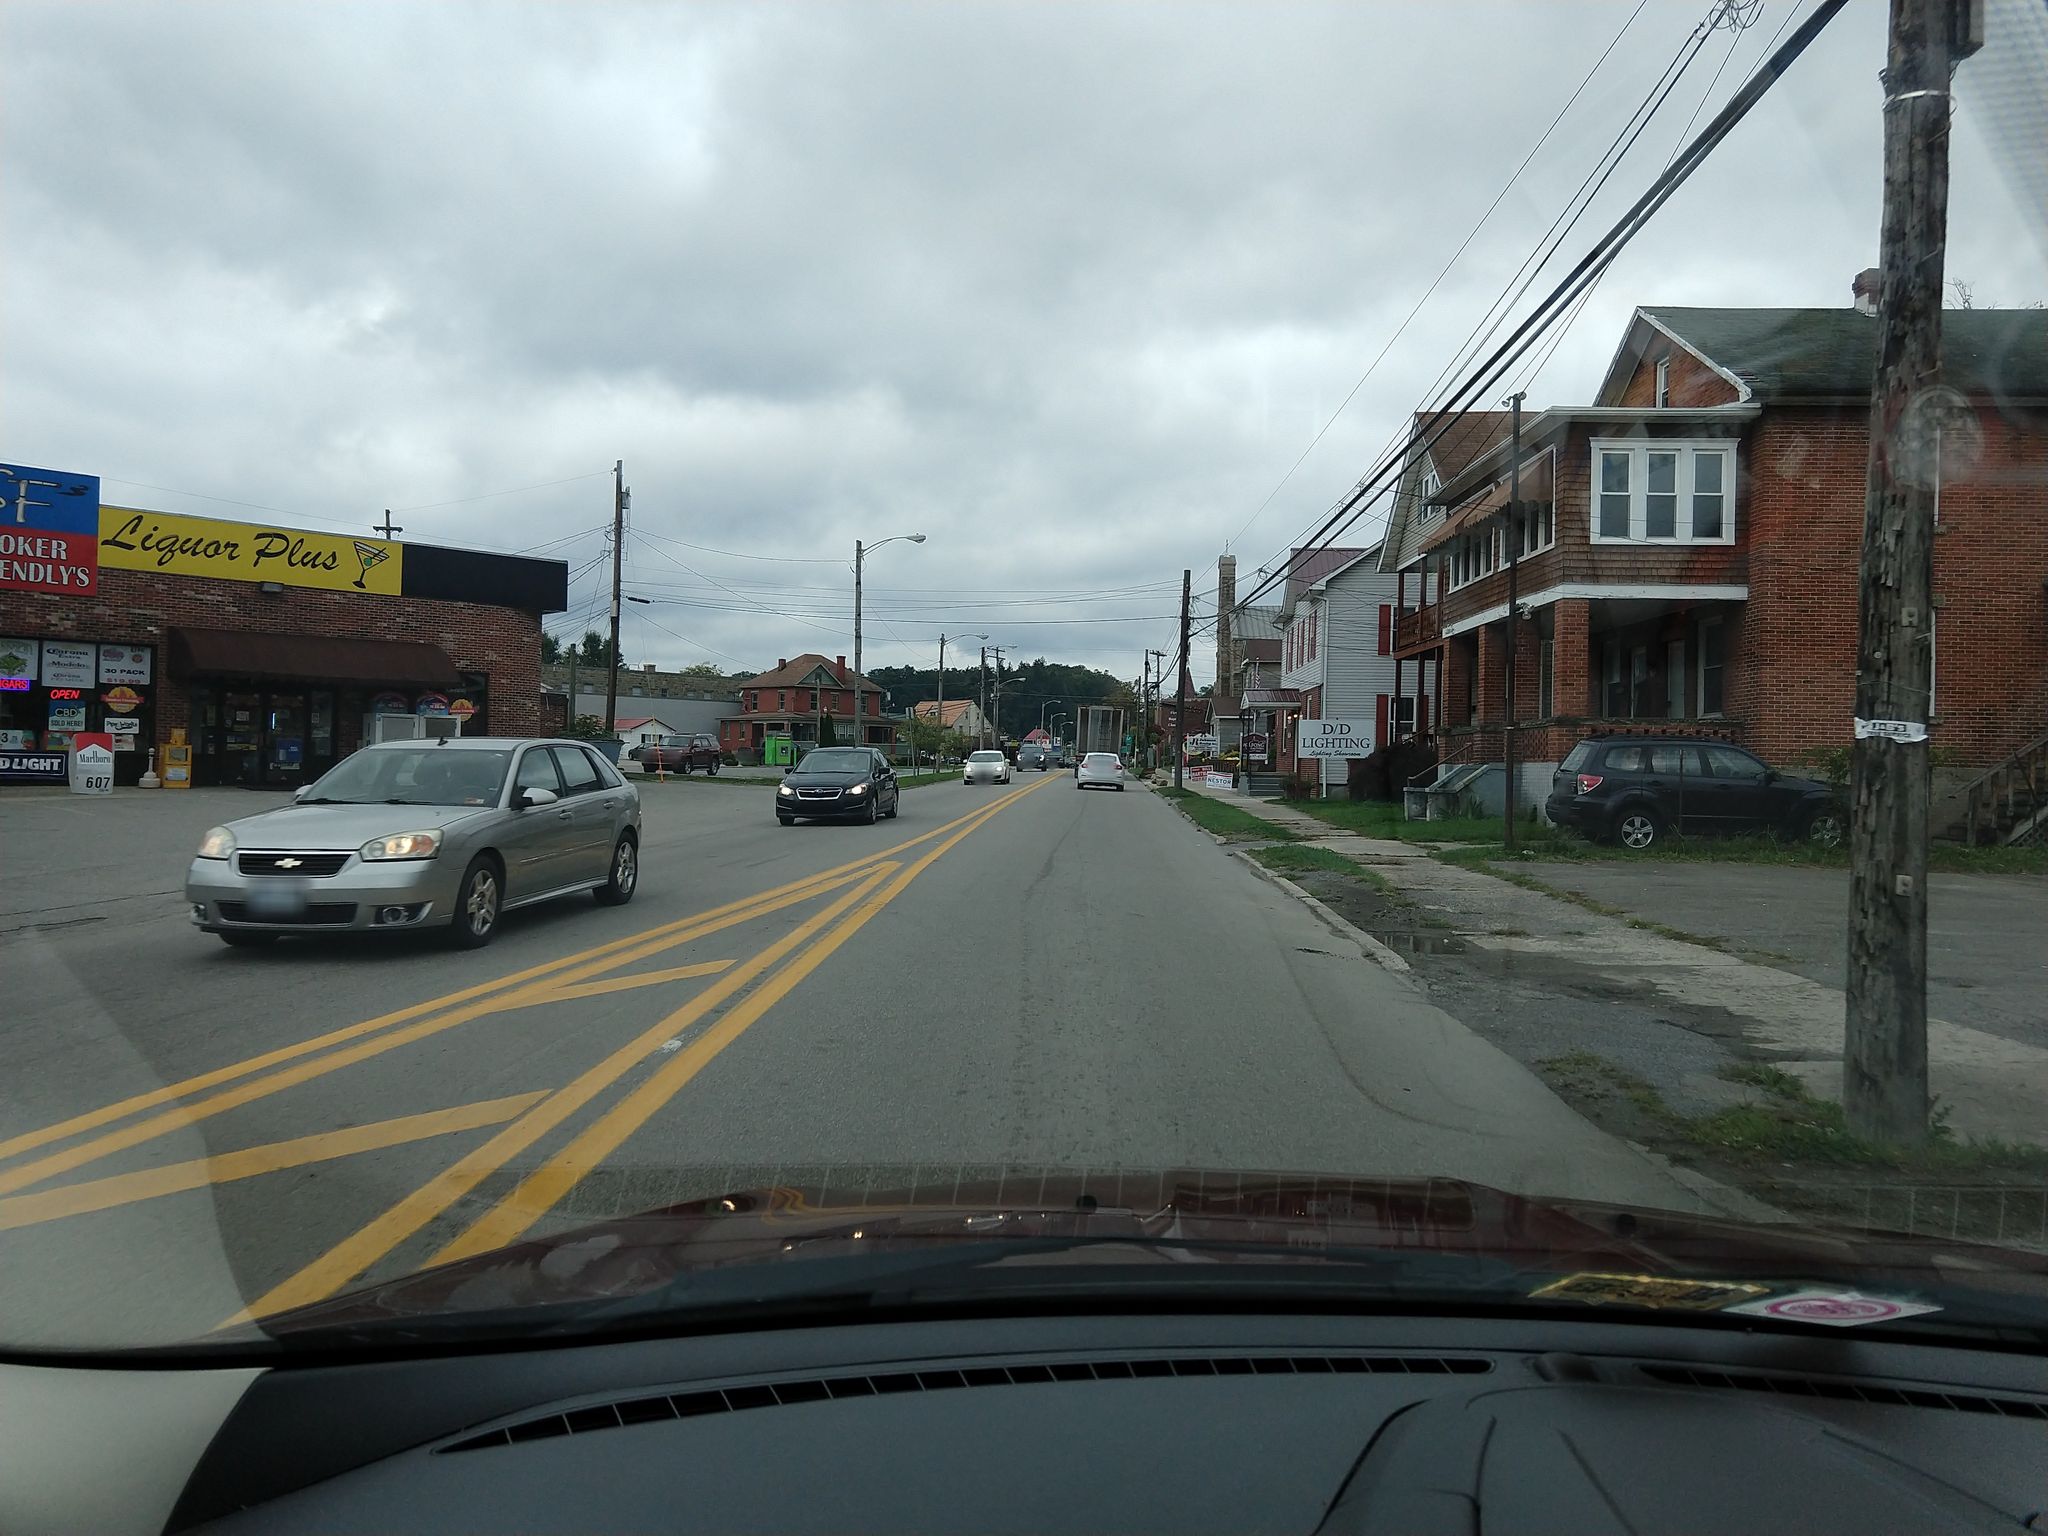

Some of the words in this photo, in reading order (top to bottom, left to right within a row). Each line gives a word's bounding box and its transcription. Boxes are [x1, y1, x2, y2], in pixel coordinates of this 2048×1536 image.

[100, 514, 241, 567] Liquor
[252, 532, 340, 571] Plus
[50, 689, 80, 700] OPEN
[55, 707, 79, 718] CBD
[1321, 724, 1351, 735] D/D
[1302, 738, 1370, 748] LIGHTING
[80, 751, 111, 763] Marlboro
[12, 758, 62, 771] LIGHT
[86, 776, 111, 789] 607
